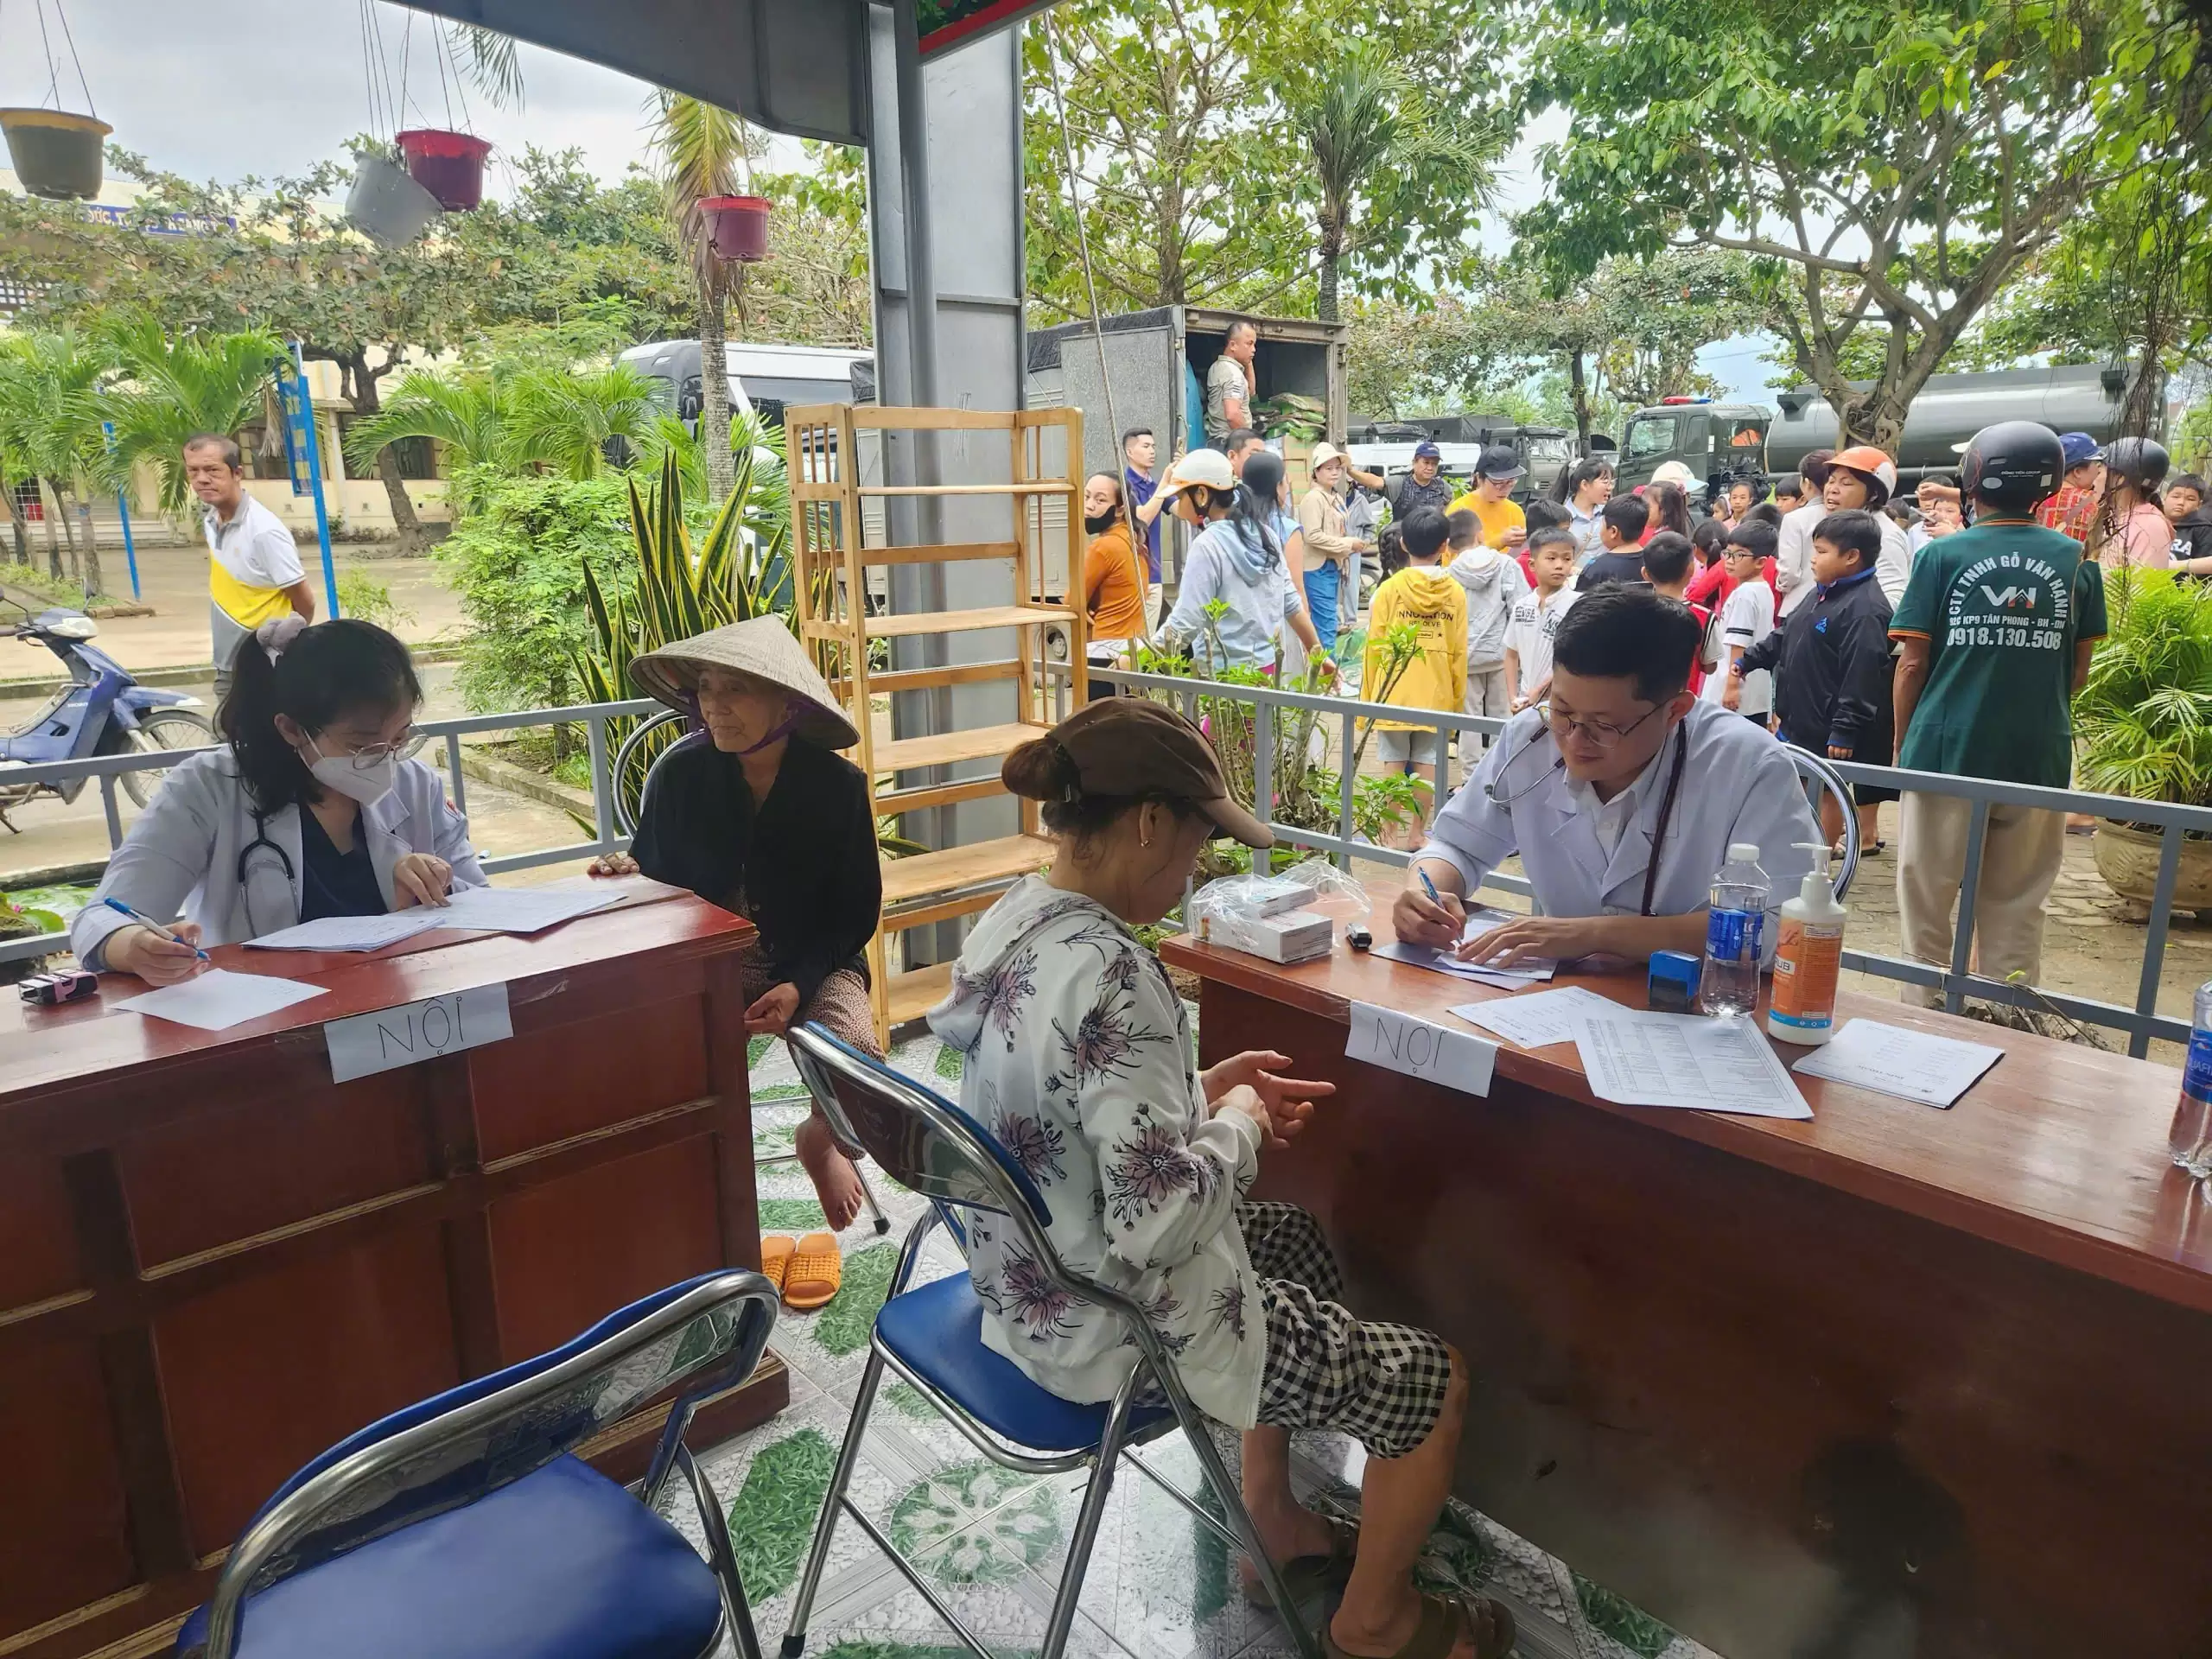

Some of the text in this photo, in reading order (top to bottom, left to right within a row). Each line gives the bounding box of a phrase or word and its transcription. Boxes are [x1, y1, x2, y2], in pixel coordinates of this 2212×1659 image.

[1948, 551, 2069, 619] CTY TNHH GỖ VĂN HẠNH
[1962, 615, 1980, 625] KP9
[1982, 613, 2000, 625] TÂN
[2002, 616, 2030, 626] PHONG
[2037, 617, 2050, 627] BH
[1947, 627, 2063, 651] 0918.130.508
